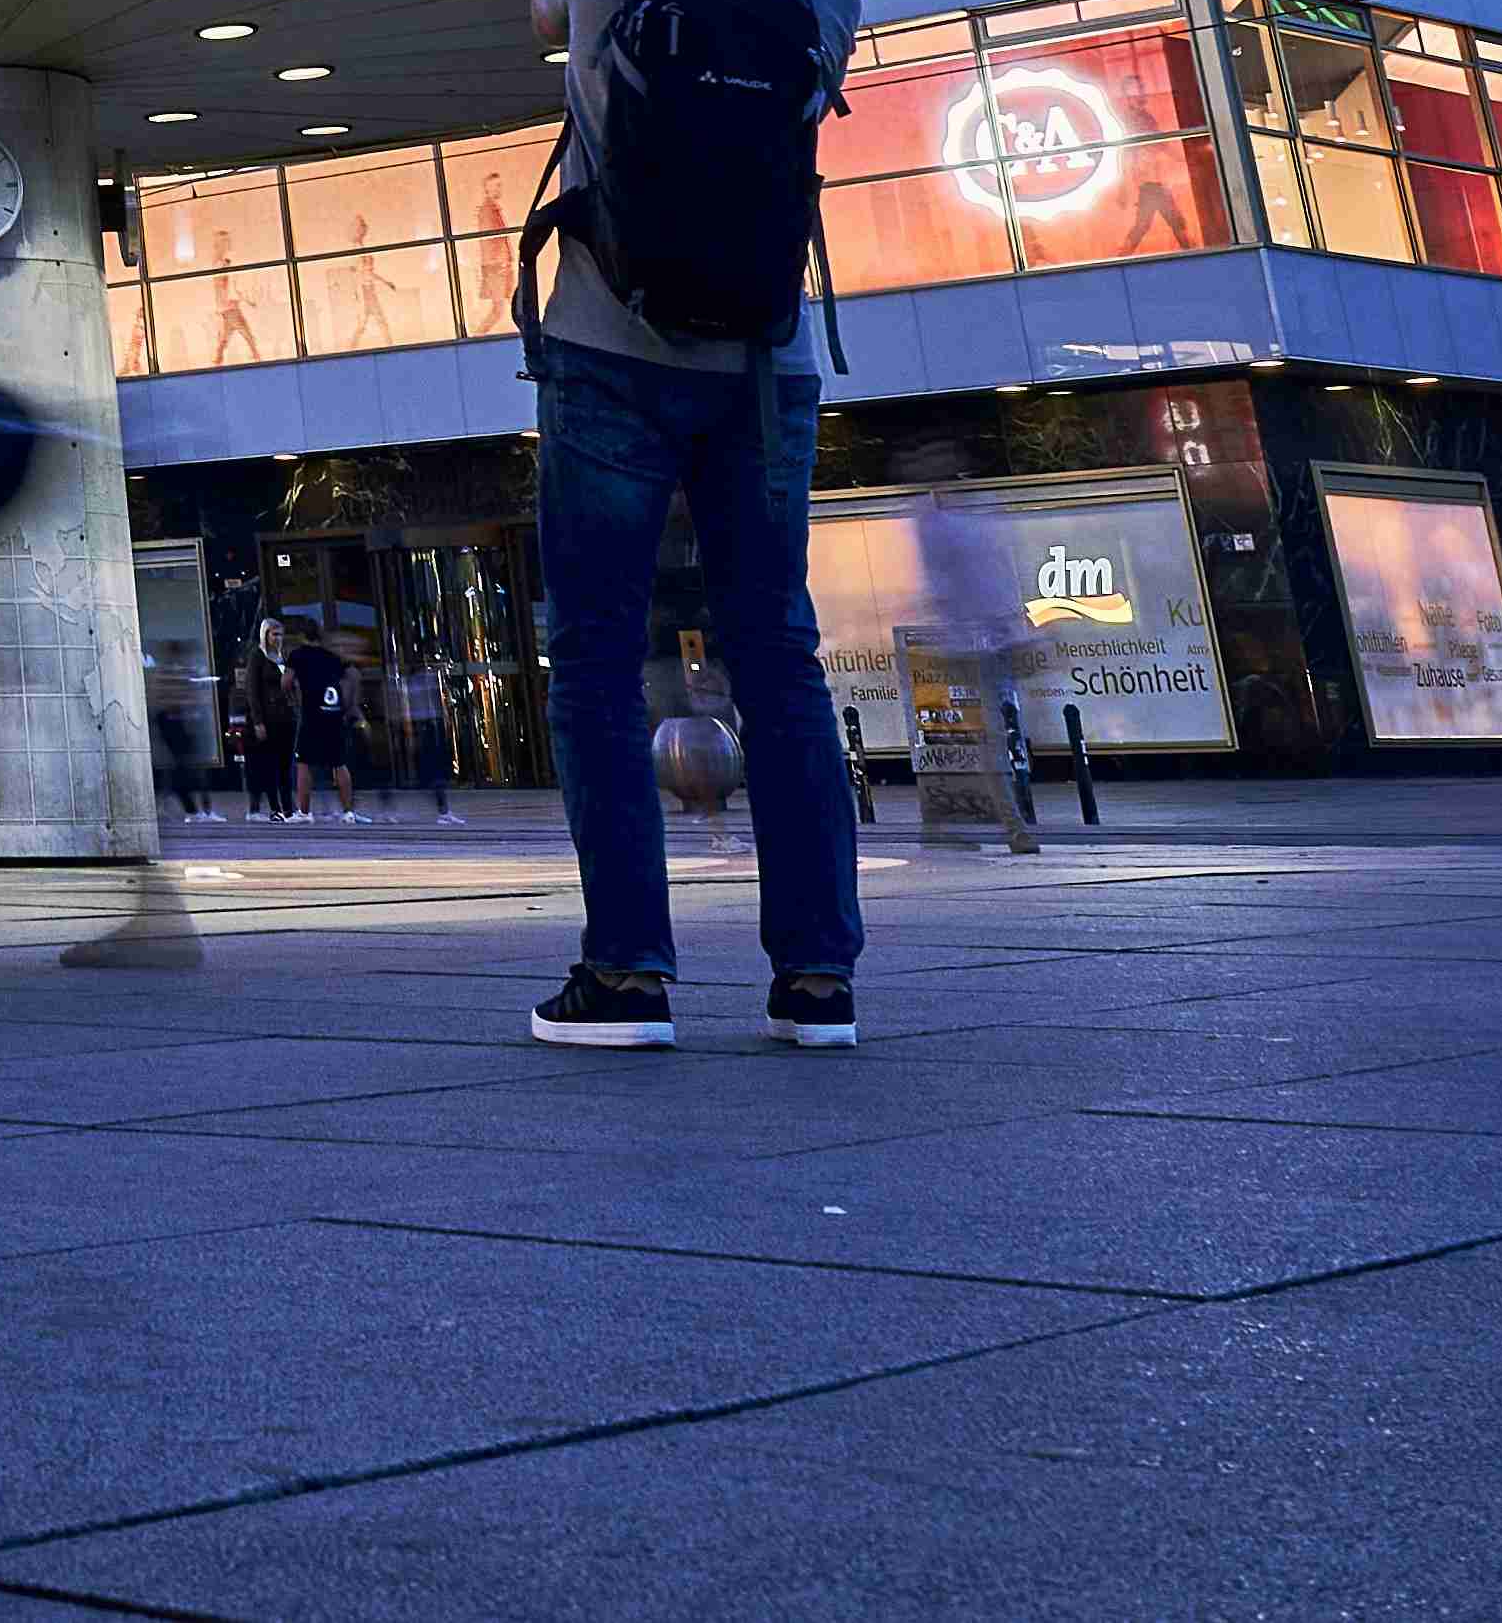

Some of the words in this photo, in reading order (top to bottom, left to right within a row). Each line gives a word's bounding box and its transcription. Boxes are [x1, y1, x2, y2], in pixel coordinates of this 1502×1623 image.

[723, 75, 772, 91] VAUDE
[976, 105, 1104, 178] C&A
[1038, 545, 1113, 598] dm
[1476, 610, 1502, 633] Foto
[1055, 638, 1167, 659] Menschlichkeit
[1071, 662, 1209, 696] Schönheit
[1413, 662, 1467, 689] Zuhause
[850, 684, 900, 701] Familie
